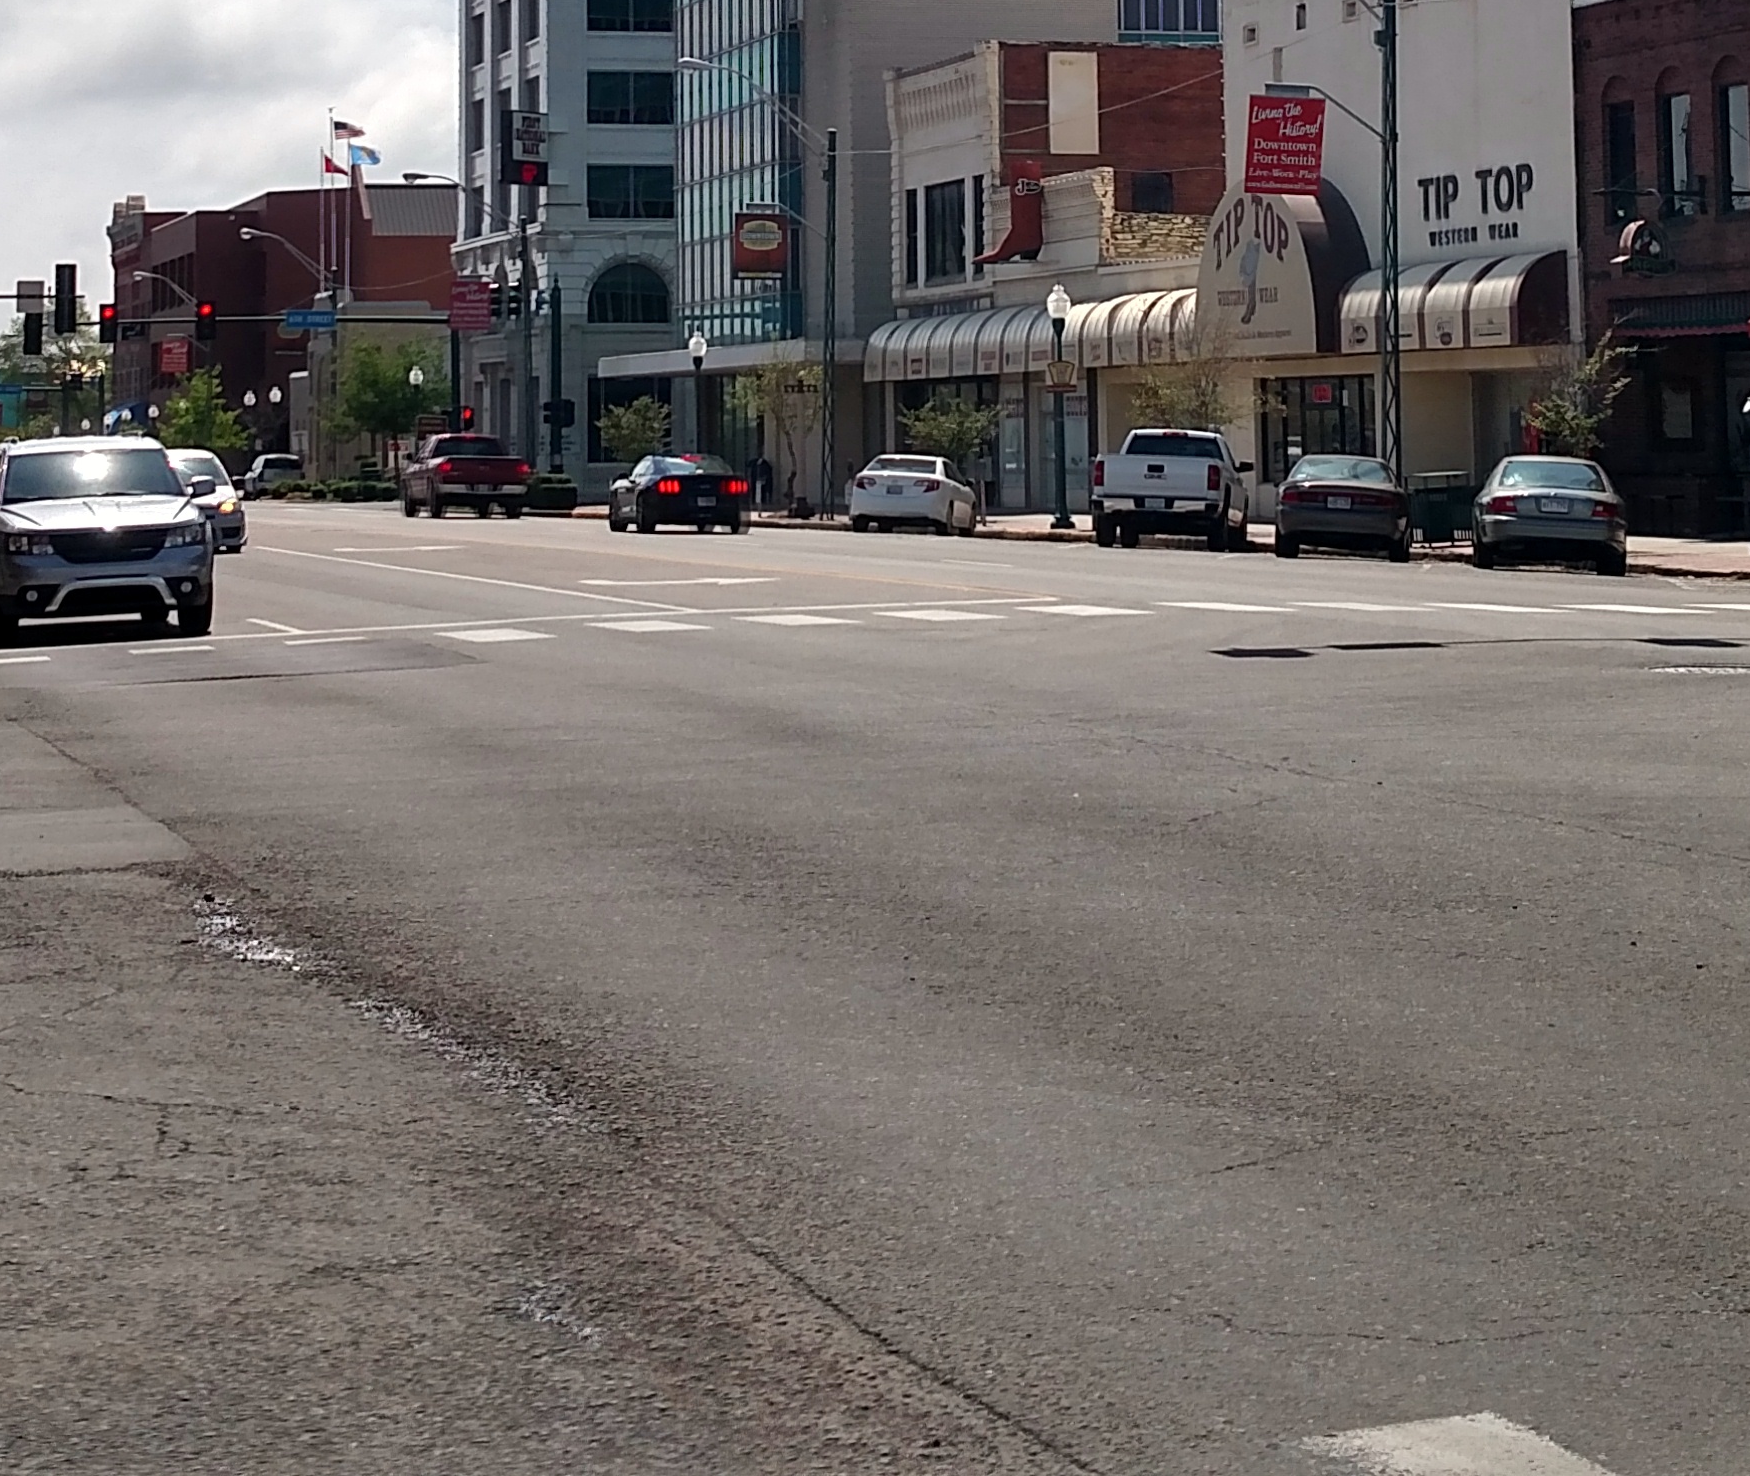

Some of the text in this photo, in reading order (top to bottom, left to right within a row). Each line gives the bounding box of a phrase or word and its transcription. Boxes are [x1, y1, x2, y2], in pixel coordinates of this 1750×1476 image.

[1279, 114, 1322, 138] History!
[1254, 138, 1317, 151] Downtown
[1253, 152, 1315, 165] Fort Smith
[1417, 163, 1534, 222] TIP TOP
[1213, 194, 1289, 271] TIP TOP
[1429, 222, 1519, 247] WESTERN WEAR
